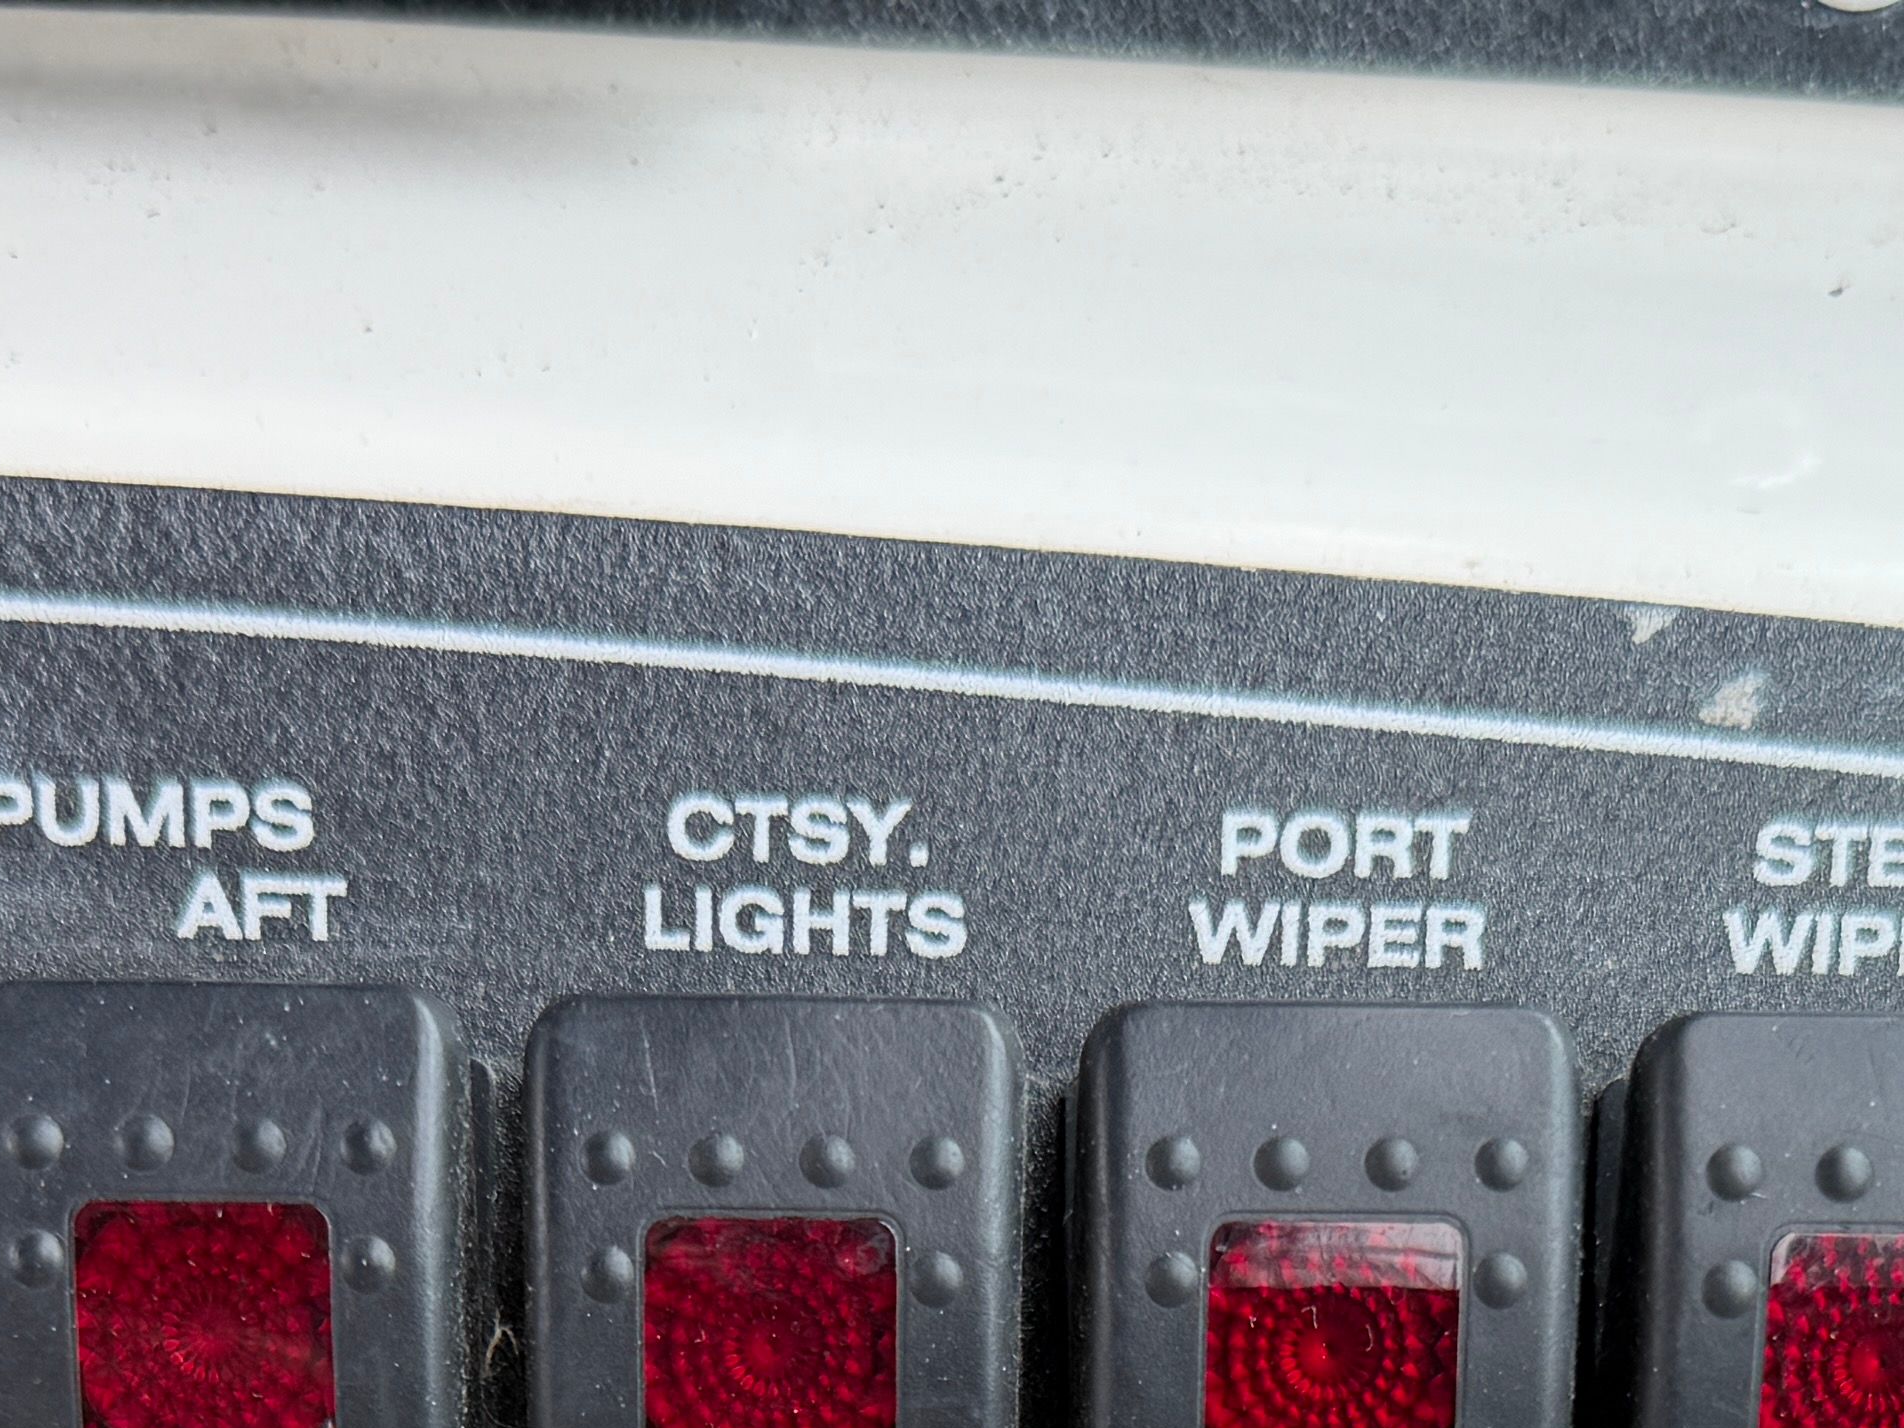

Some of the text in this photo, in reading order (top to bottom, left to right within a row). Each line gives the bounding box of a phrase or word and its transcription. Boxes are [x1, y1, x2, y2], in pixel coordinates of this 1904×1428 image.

[667, 796, 929, 871] CTSY.
[1220, 806, 1470, 882] PORT
[178, 874, 346, 943] AFT
[642, 884, 967, 963] LIGHTS
[1190, 896, 1488, 972] WIPER
